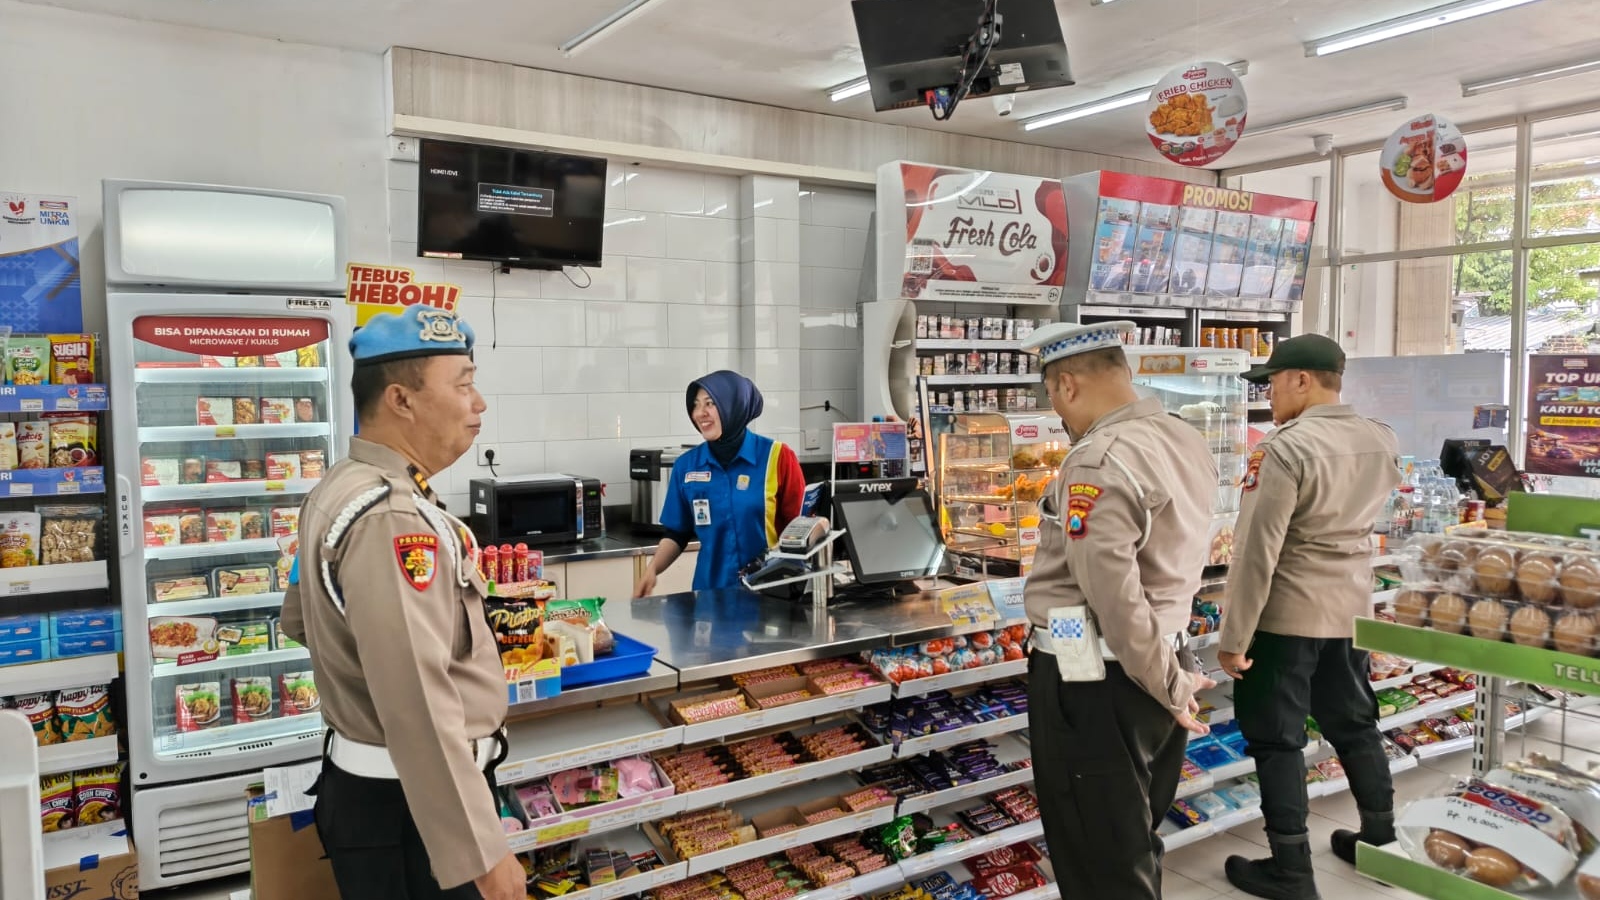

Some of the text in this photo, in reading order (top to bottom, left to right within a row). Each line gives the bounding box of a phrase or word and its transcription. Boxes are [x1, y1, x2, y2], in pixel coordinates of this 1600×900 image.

[1158, 78, 1233, 102] FRIED CHICKEN
[1183, 185, 1253, 211] PROMOSI
[40, 210, 69, 219] MITRA
[40, 218, 70, 226] UMKM
[943, 216, 1037, 256] Fresh Cola
[350, 266, 411, 284] TEBUS
[349, 283, 459, 311] HEBOH!
[287, 299, 330, 308] FRESTA
[154, 327, 310, 337] BISA DIPANASKAN DI RUMAH
[190, 338, 243, 346] MICROWAVE
[251, 338, 279, 346] KUKUS
[53, 343, 87, 356] SUGIH
[1546, 373, 1580, 383] TOP
[1540, 405, 1583, 414] KARTU
[399, 536, 435, 545] PROPAM
[95, 788, 112, 798] CHIPS
